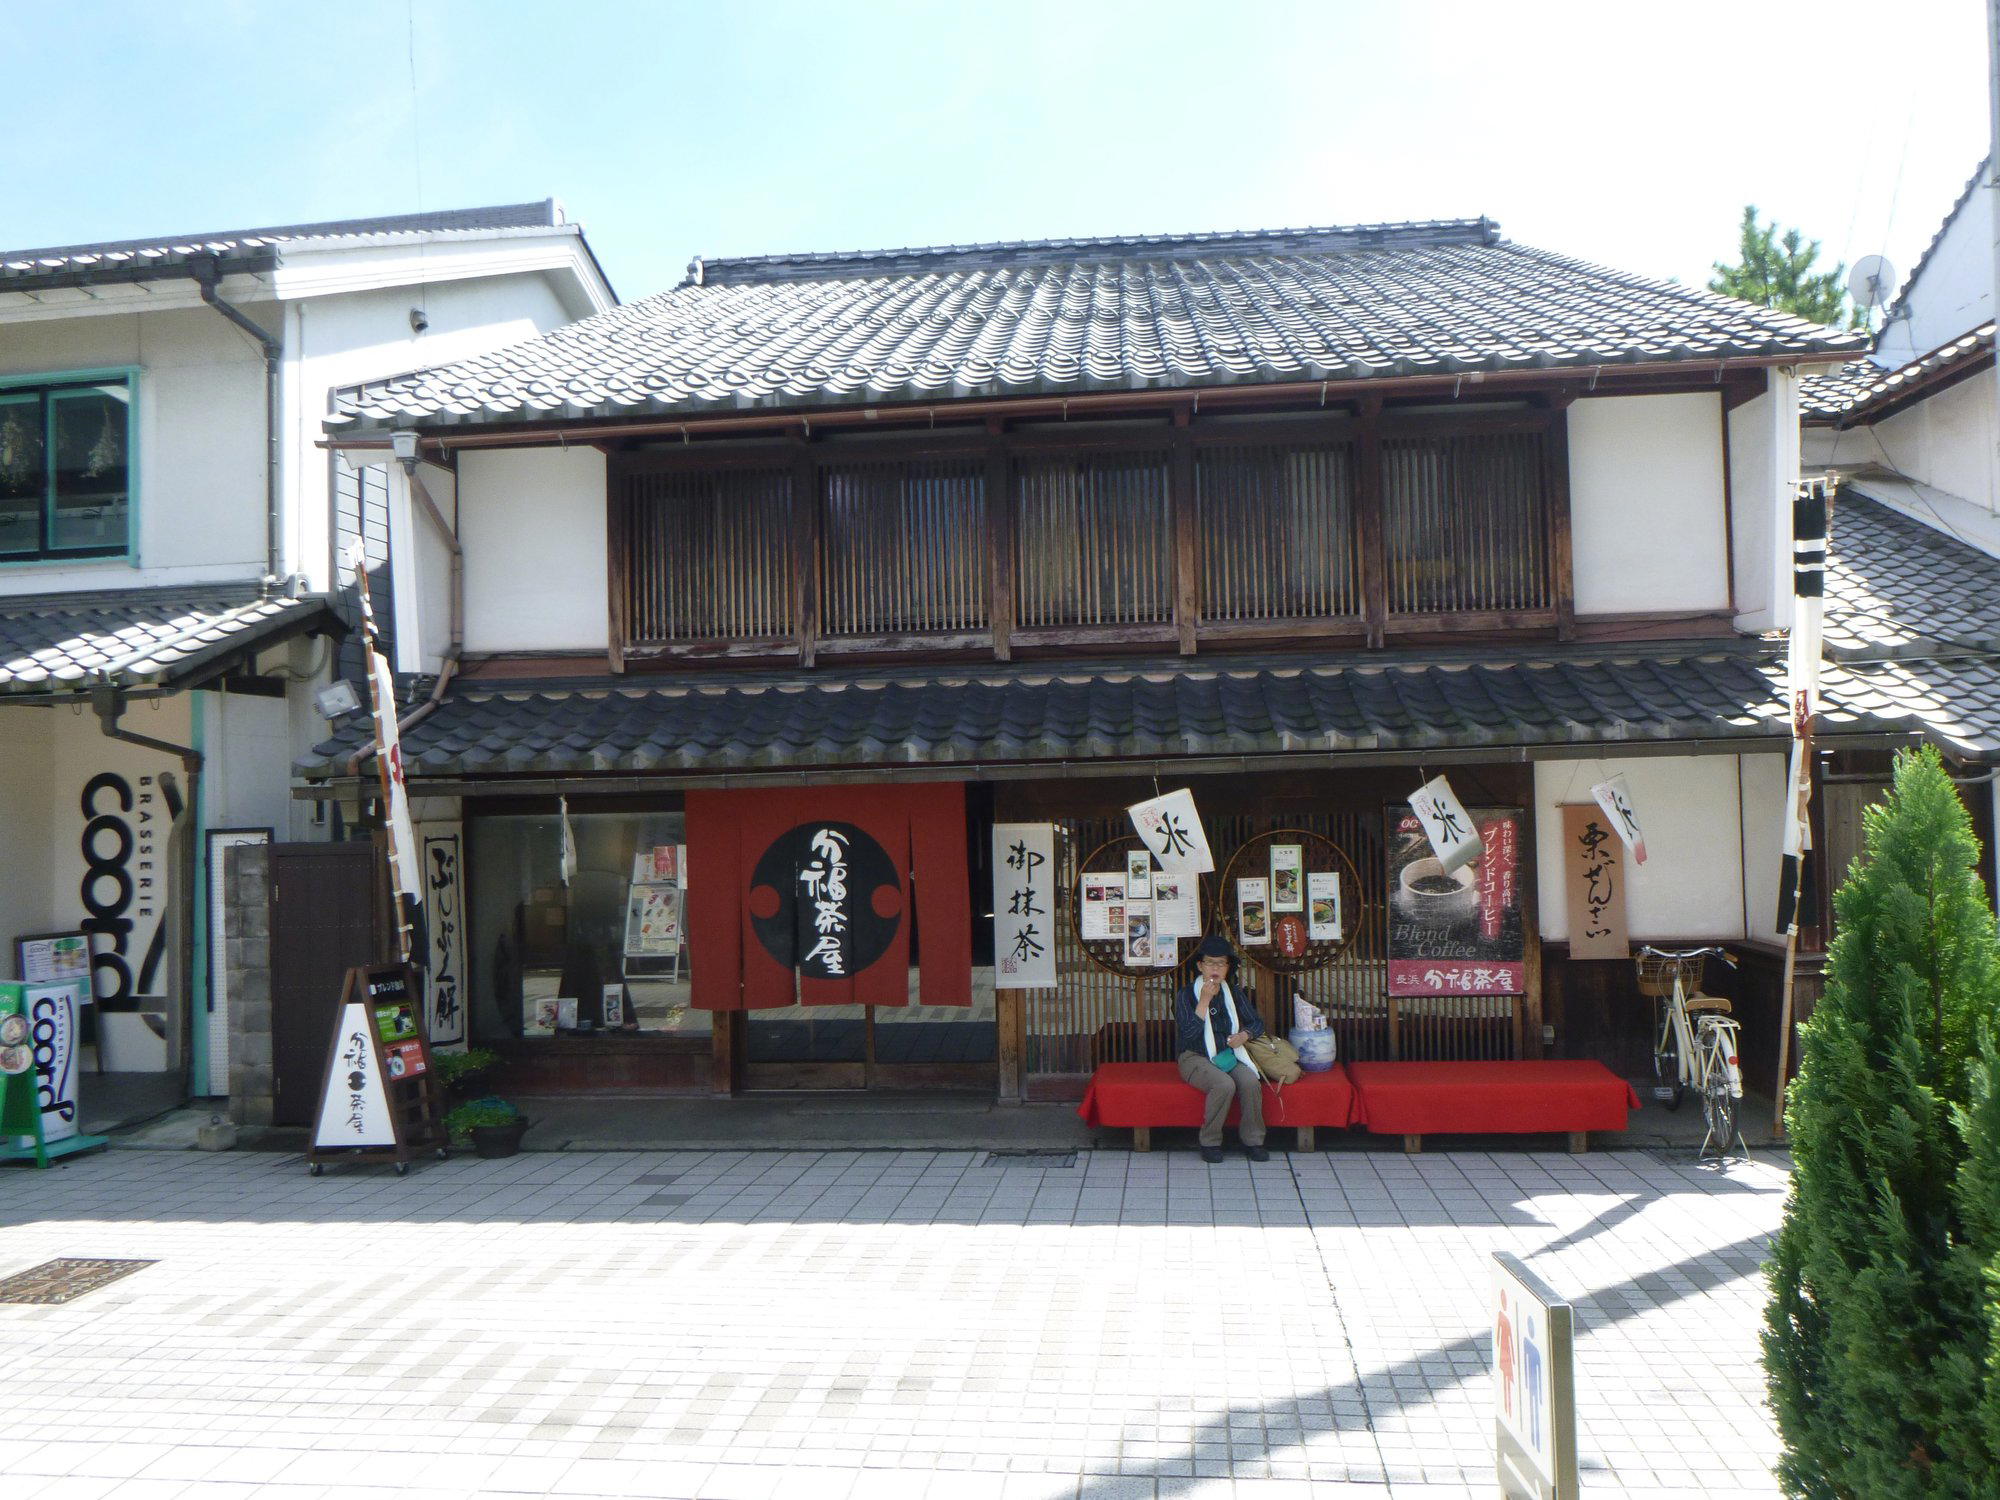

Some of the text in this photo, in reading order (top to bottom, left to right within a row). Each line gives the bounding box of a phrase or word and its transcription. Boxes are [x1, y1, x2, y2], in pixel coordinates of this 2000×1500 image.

[138, 776, 153, 917] BRASSERIE
[1484, 828, 1499, 936] ブレンドコーヒー
[1006, 839, 1046, 963] 御抹茶
[1394, 924, 1451, 941] Blend
[1417, 940, 1477, 958] Coffee
